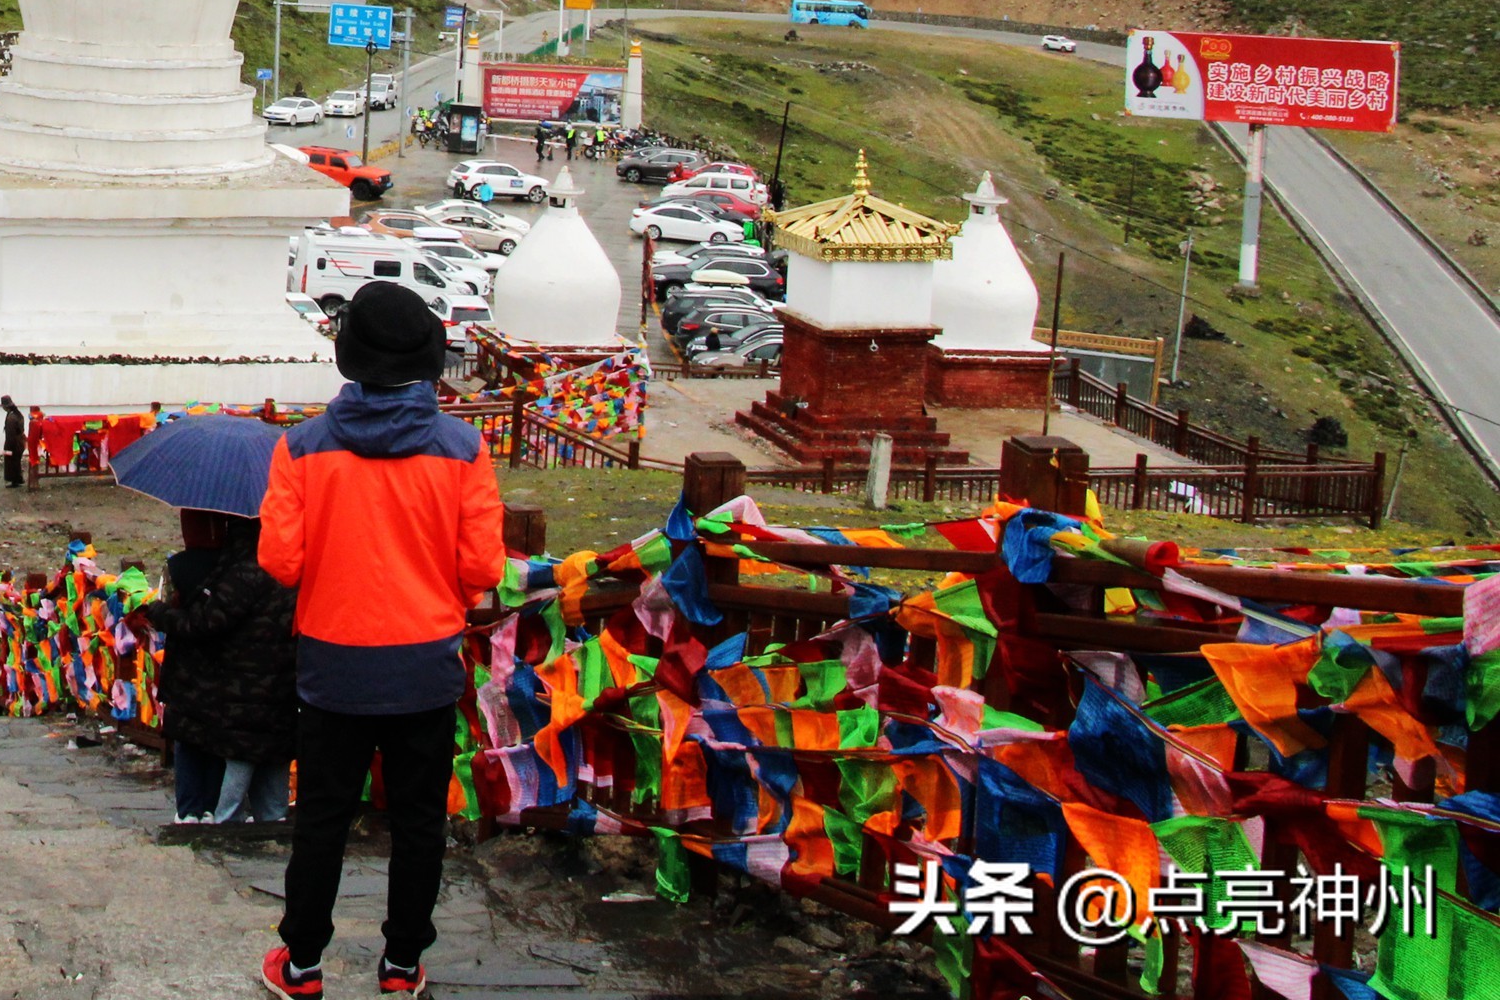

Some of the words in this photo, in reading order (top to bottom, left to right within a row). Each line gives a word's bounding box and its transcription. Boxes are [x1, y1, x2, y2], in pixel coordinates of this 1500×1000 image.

[335, 7, 388, 20] 连续下坡
[1208, 62, 1390, 91] 实施乡村振兴战略
[1207, 81, 1388, 112] 建设新时代美丽乡村
